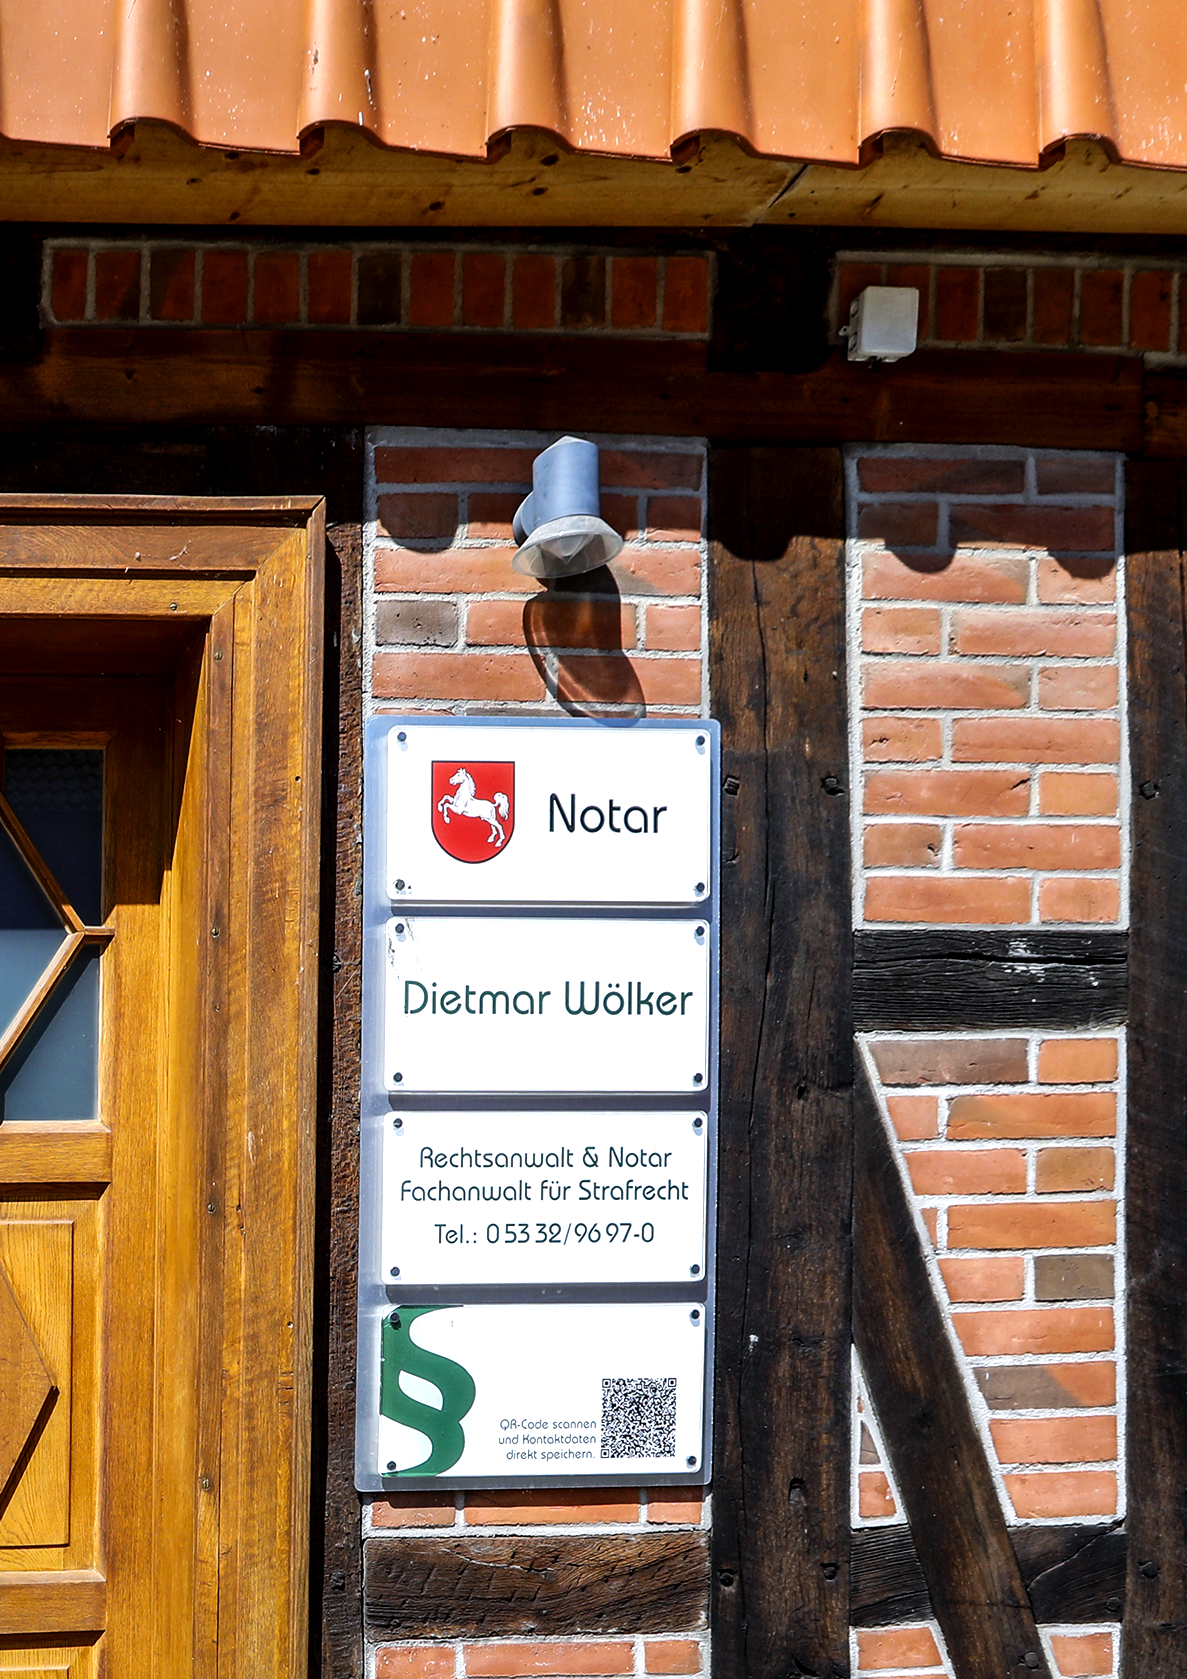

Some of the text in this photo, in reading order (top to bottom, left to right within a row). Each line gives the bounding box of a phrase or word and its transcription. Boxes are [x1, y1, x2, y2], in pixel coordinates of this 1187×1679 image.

[548, 792, 668, 834] Notar
[403, 980, 694, 1016] Dietmar Wölker
[419, 1146, 673, 1169] Rechtsanwalt & Notar
[400, 1178, 689, 1202] Fachanwalt für Strafrecht
[433, 1223, 478, 1245] Tel.:
[499, 1418, 597, 1431] QR-Code scannen
[498, 1433, 597, 1445] und Kontaktdaten
[505, 1448, 596, 1462] direkt speichern.
